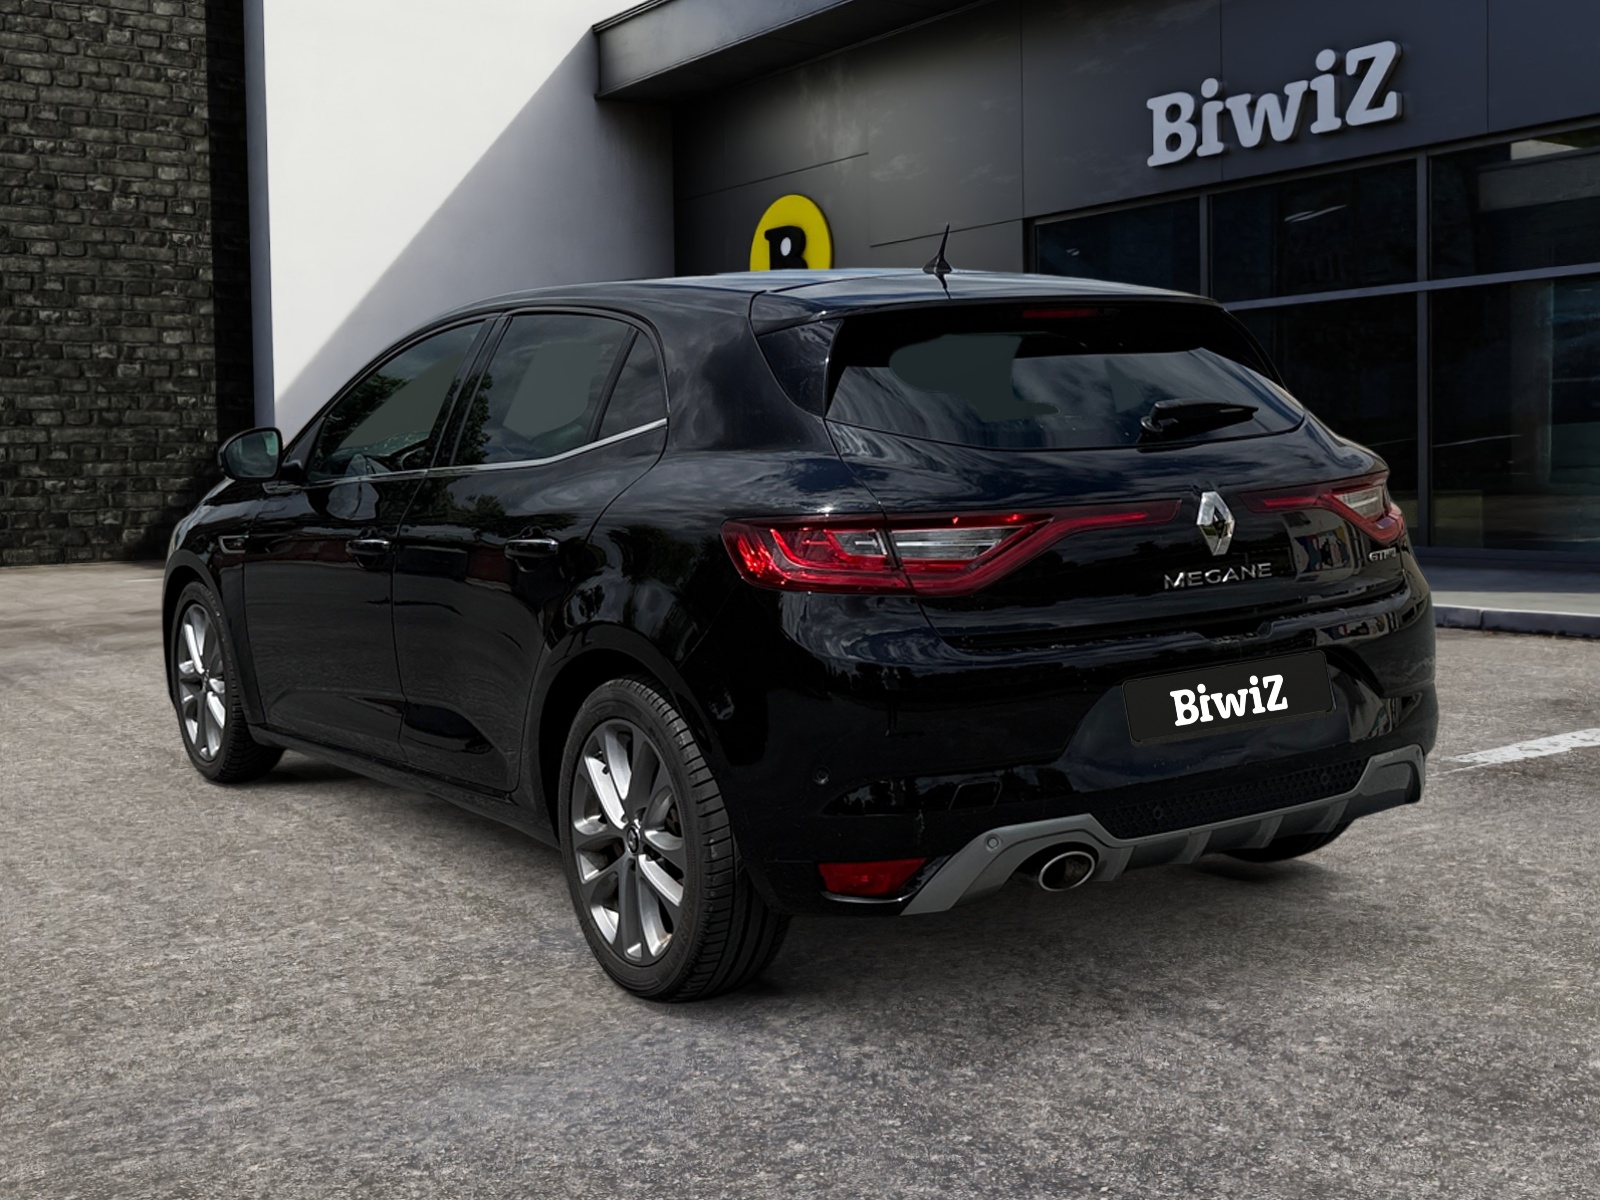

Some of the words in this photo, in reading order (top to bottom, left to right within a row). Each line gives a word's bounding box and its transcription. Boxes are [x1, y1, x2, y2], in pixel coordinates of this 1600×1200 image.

[1146, 40, 1400, 167] BiwiZ
[1163, 562, 1273, 590] MEGANE
[1169, 674, 1289, 727] BiwiZ
